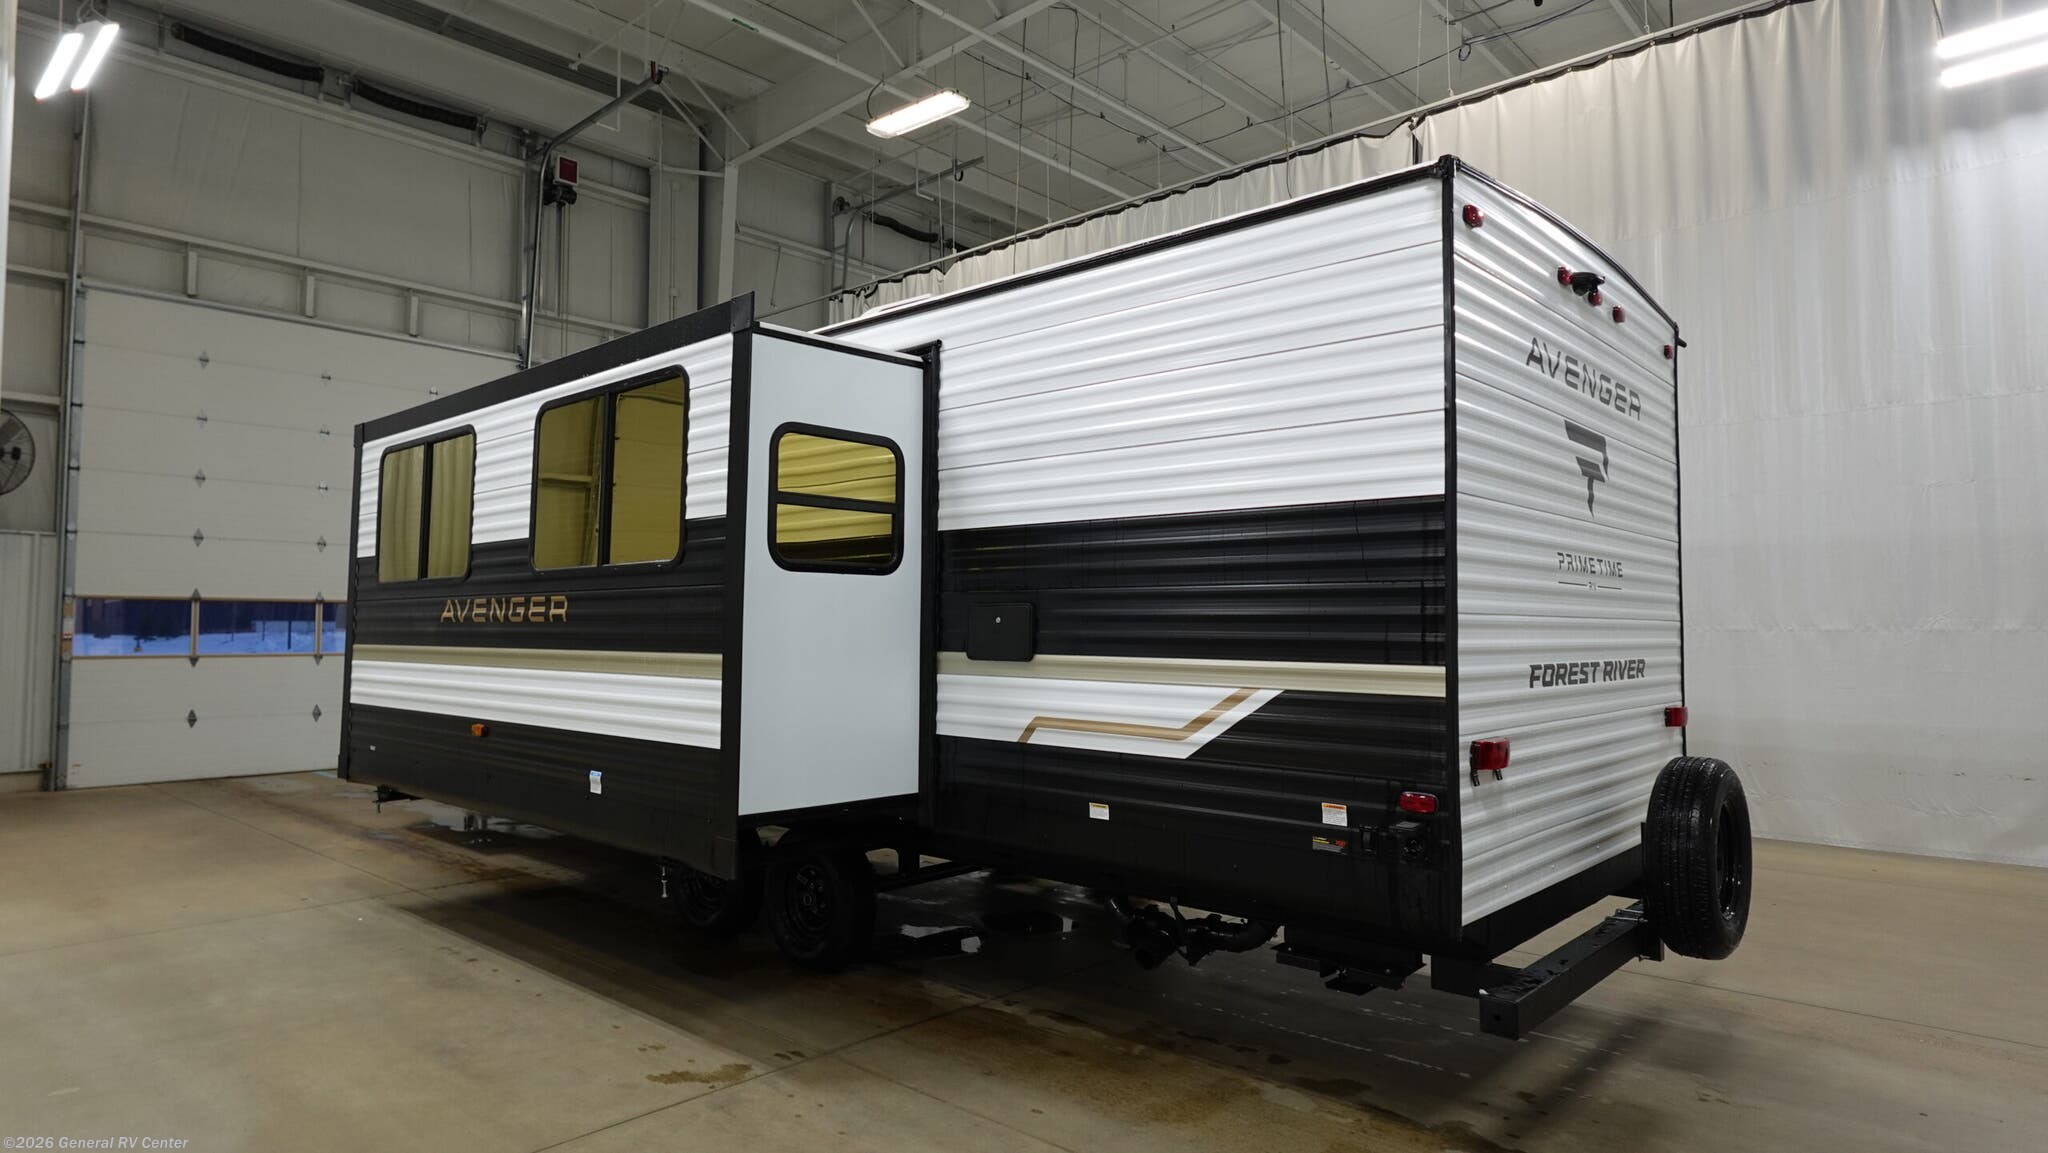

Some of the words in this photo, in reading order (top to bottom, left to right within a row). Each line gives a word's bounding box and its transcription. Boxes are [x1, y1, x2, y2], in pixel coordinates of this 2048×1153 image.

[1526, 337, 1641, 421] AVENGER
[440, 595, 568, 623] AVENGER
[1529, 661, 1600, 688] FOREST
[1603, 659, 1645, 682] RIVER
